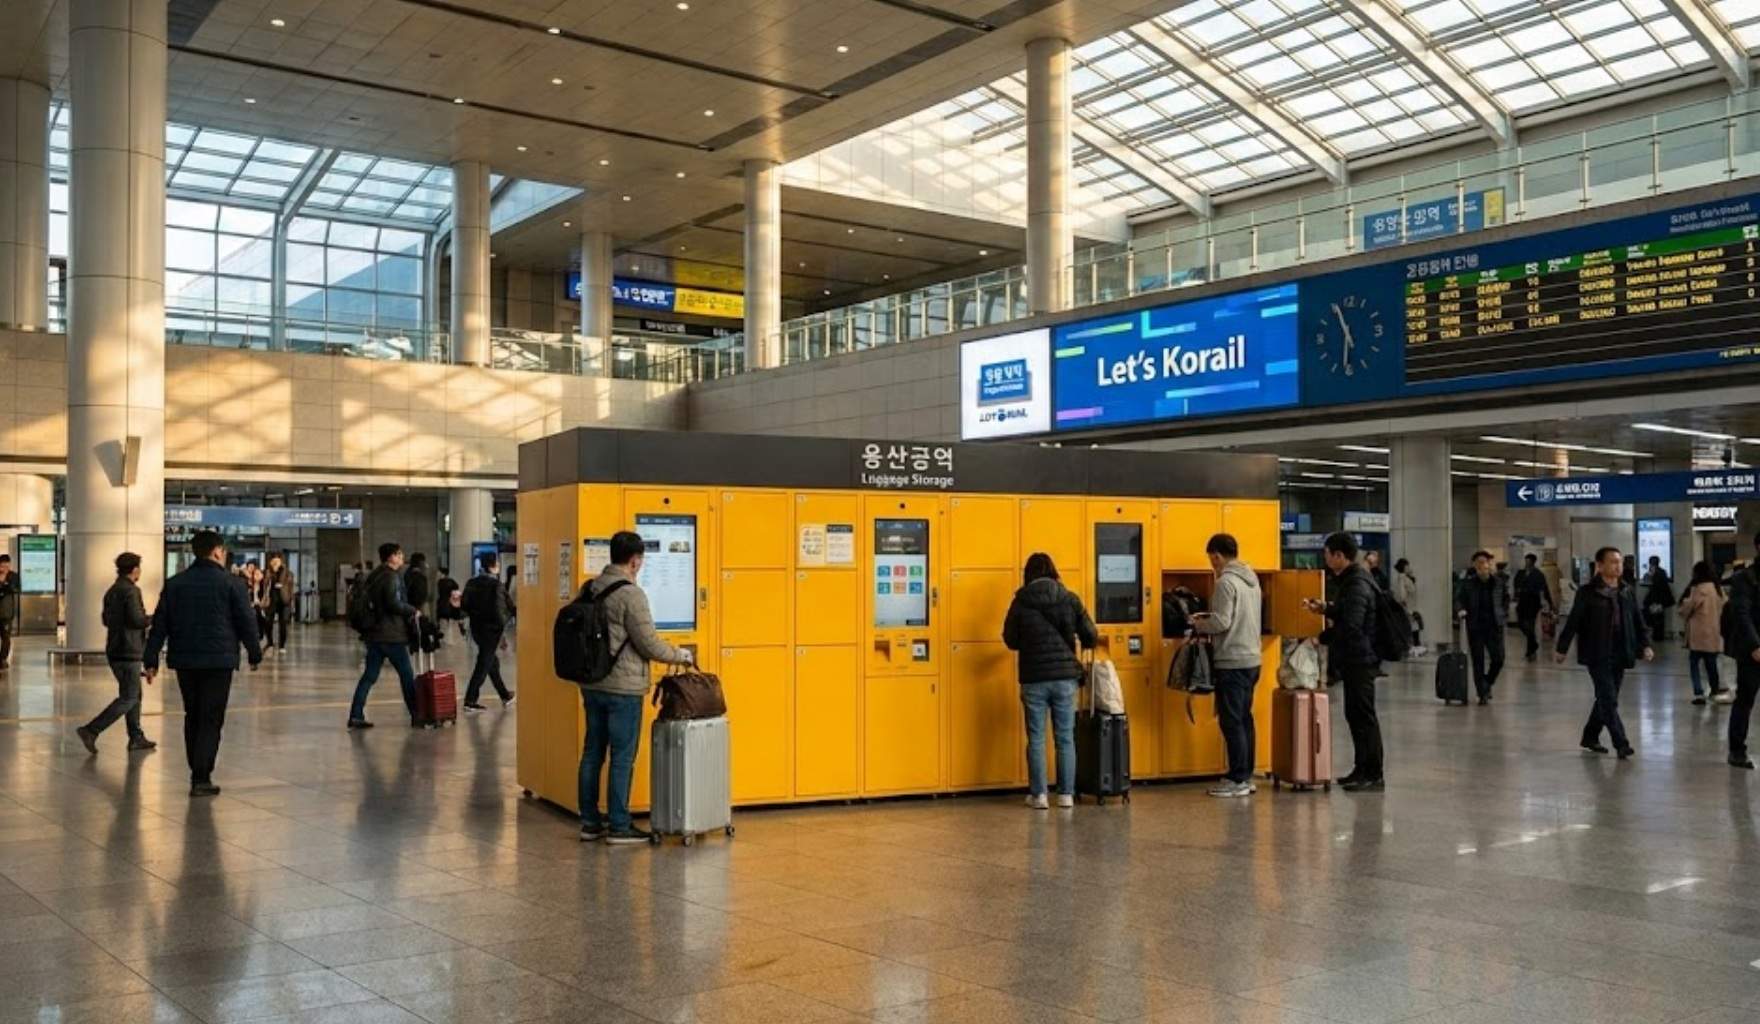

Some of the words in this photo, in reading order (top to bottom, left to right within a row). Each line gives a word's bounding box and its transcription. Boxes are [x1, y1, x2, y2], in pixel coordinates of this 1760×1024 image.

[1098, 350, 1156, 386] Let's
[1163, 335, 1245, 378] Korail
[911, 473, 954, 489] Storage
